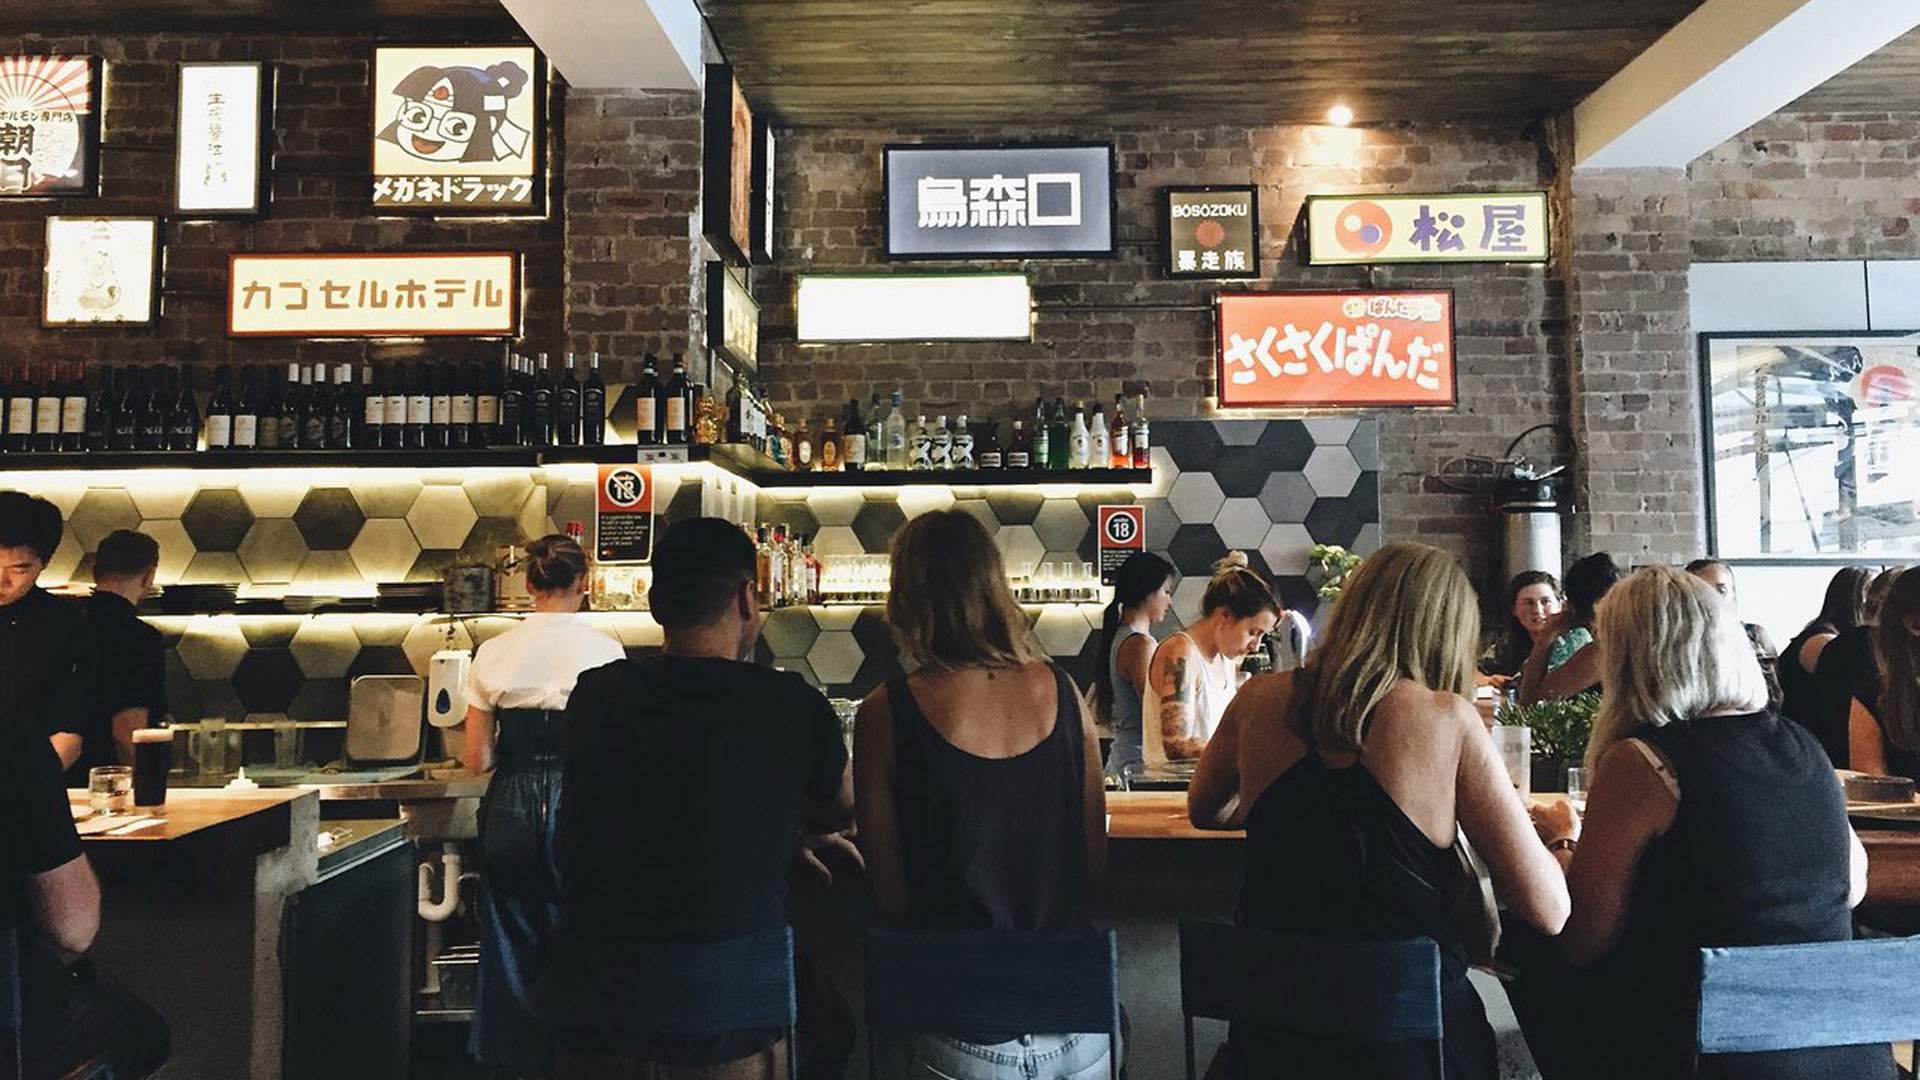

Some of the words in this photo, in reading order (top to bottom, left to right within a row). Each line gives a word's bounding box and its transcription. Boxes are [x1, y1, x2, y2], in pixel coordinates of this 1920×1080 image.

[1408, 205, 1528, 252] 松屋
[1224, 320, 1444, 390] さくさくぱんだ
[1113, 522, 1129, 538] 18
